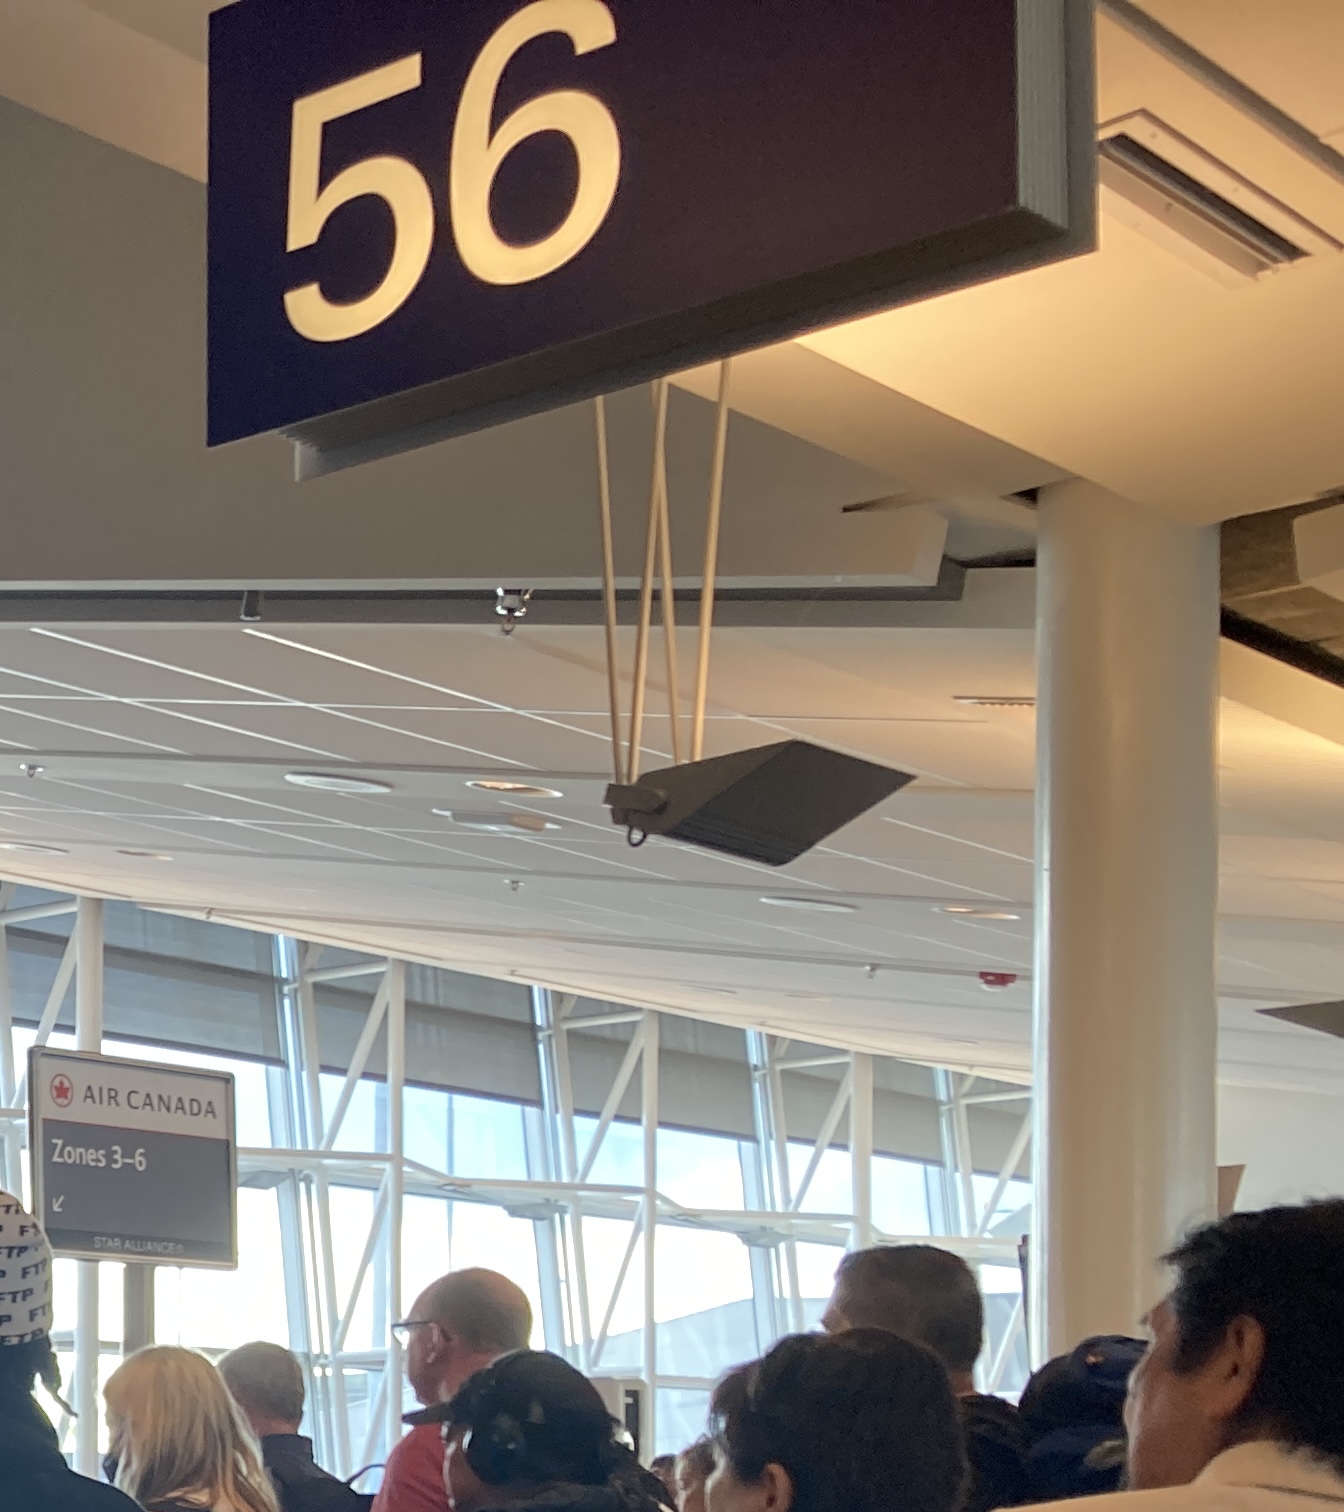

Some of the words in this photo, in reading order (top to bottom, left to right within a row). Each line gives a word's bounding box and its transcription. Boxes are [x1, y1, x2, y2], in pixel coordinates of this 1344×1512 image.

[283, 0, 622, 343] 56
[83, 1085, 120, 1107] AIR
[127, 1090, 217, 1119] CANADA
[51, 1139, 107, 1167] Zones
[93, 1236, 121, 1249] STAR
[124, 1239, 176, 1254] ALLIANCE
